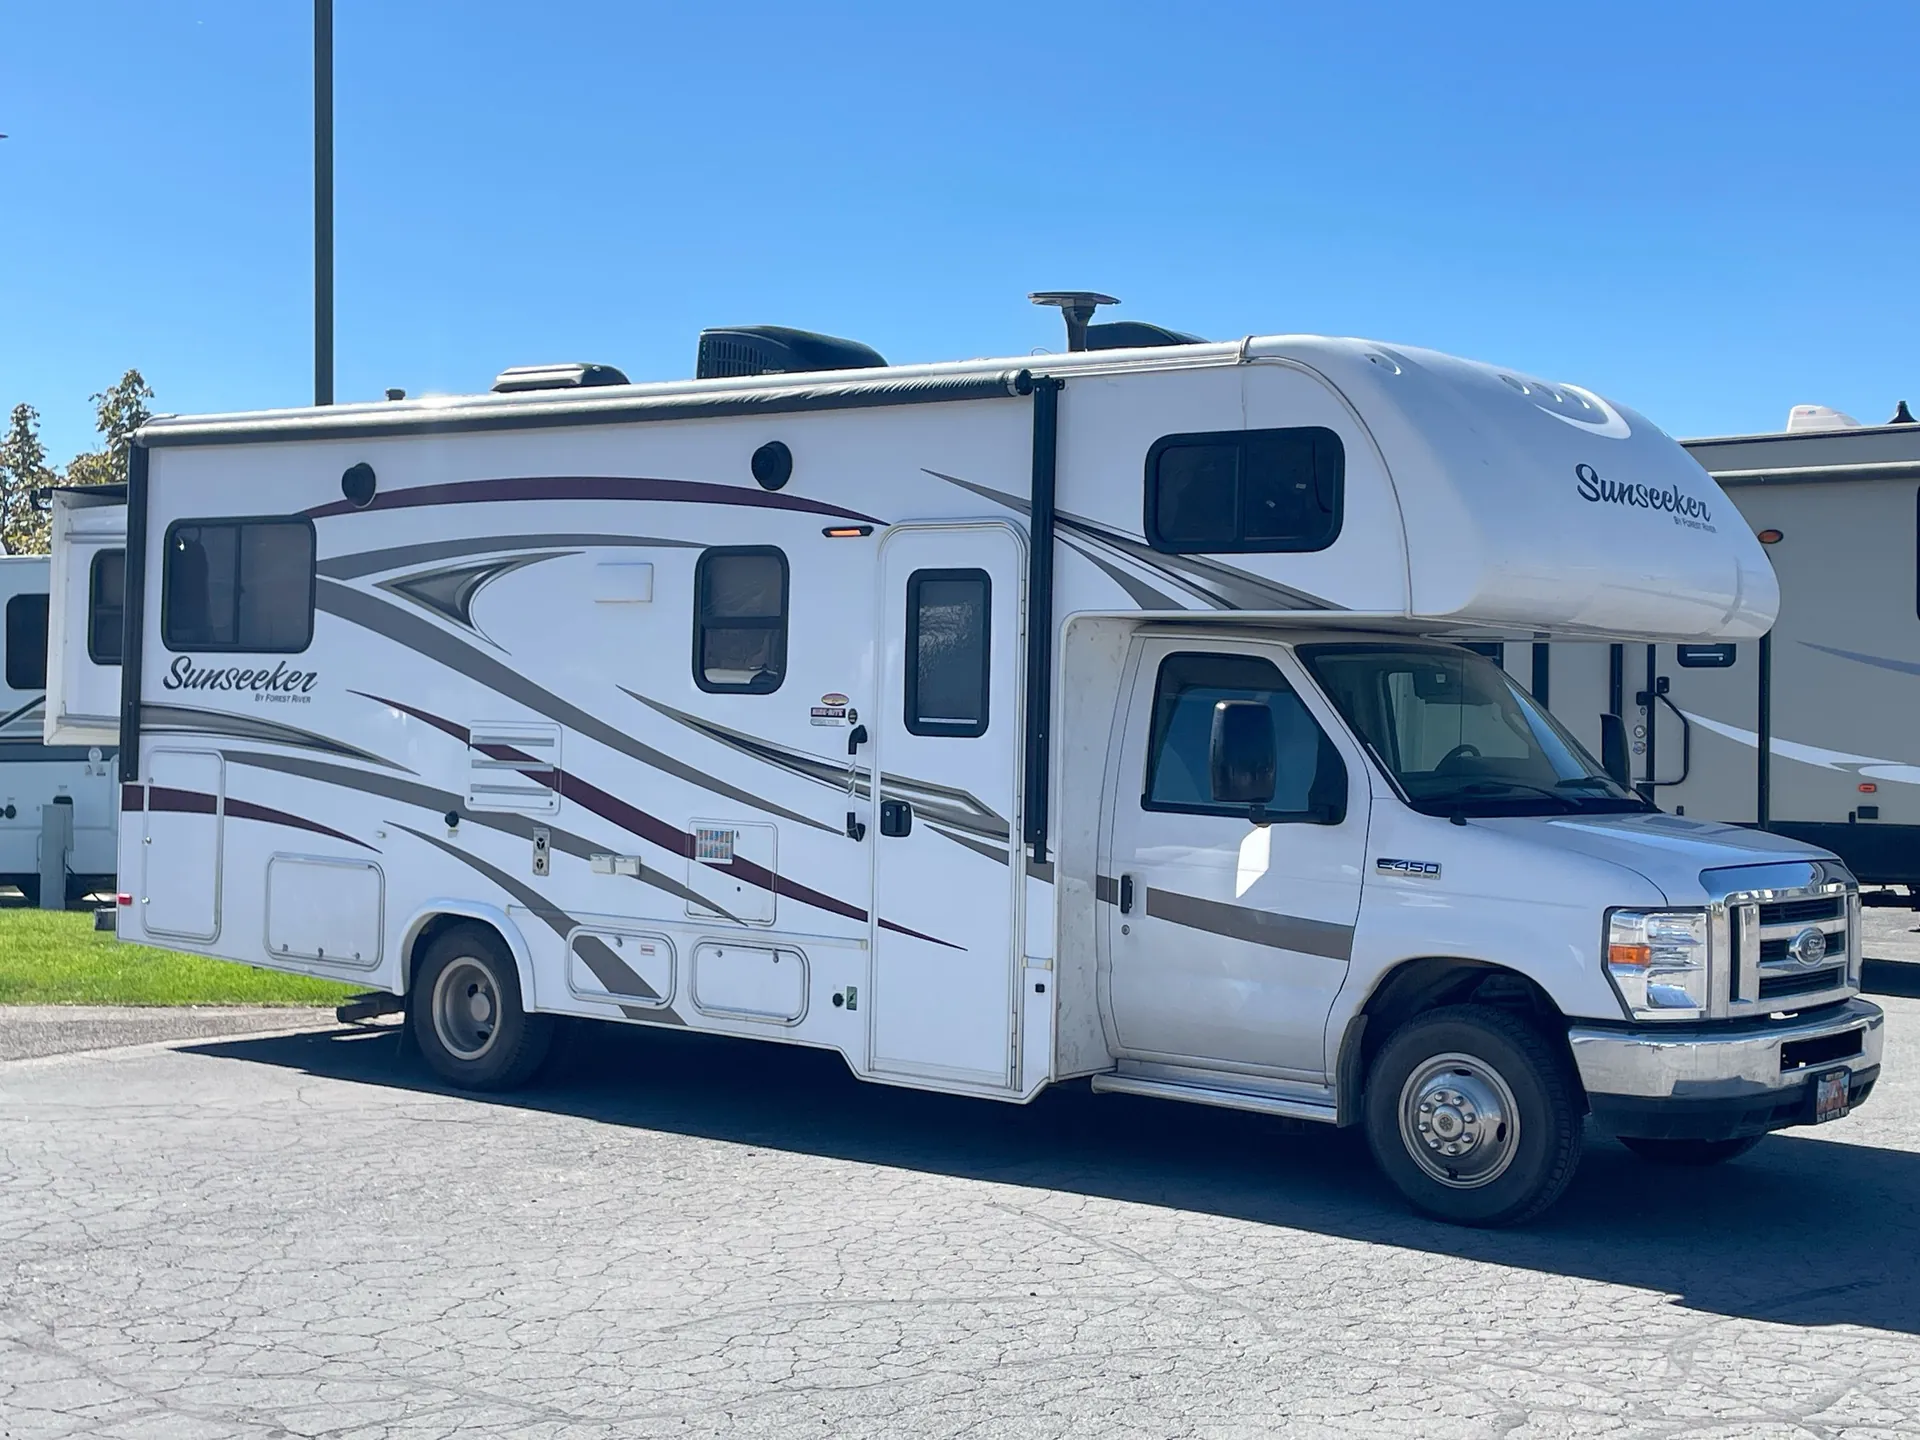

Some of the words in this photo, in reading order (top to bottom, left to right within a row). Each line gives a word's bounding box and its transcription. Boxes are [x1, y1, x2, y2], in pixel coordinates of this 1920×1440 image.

[1575, 463, 1711, 522] Sunseeker
[163, 655, 318, 693] Sunseeker
[265, 693, 291, 703] FOREST
[1377, 858, 1440, 874] E-450
